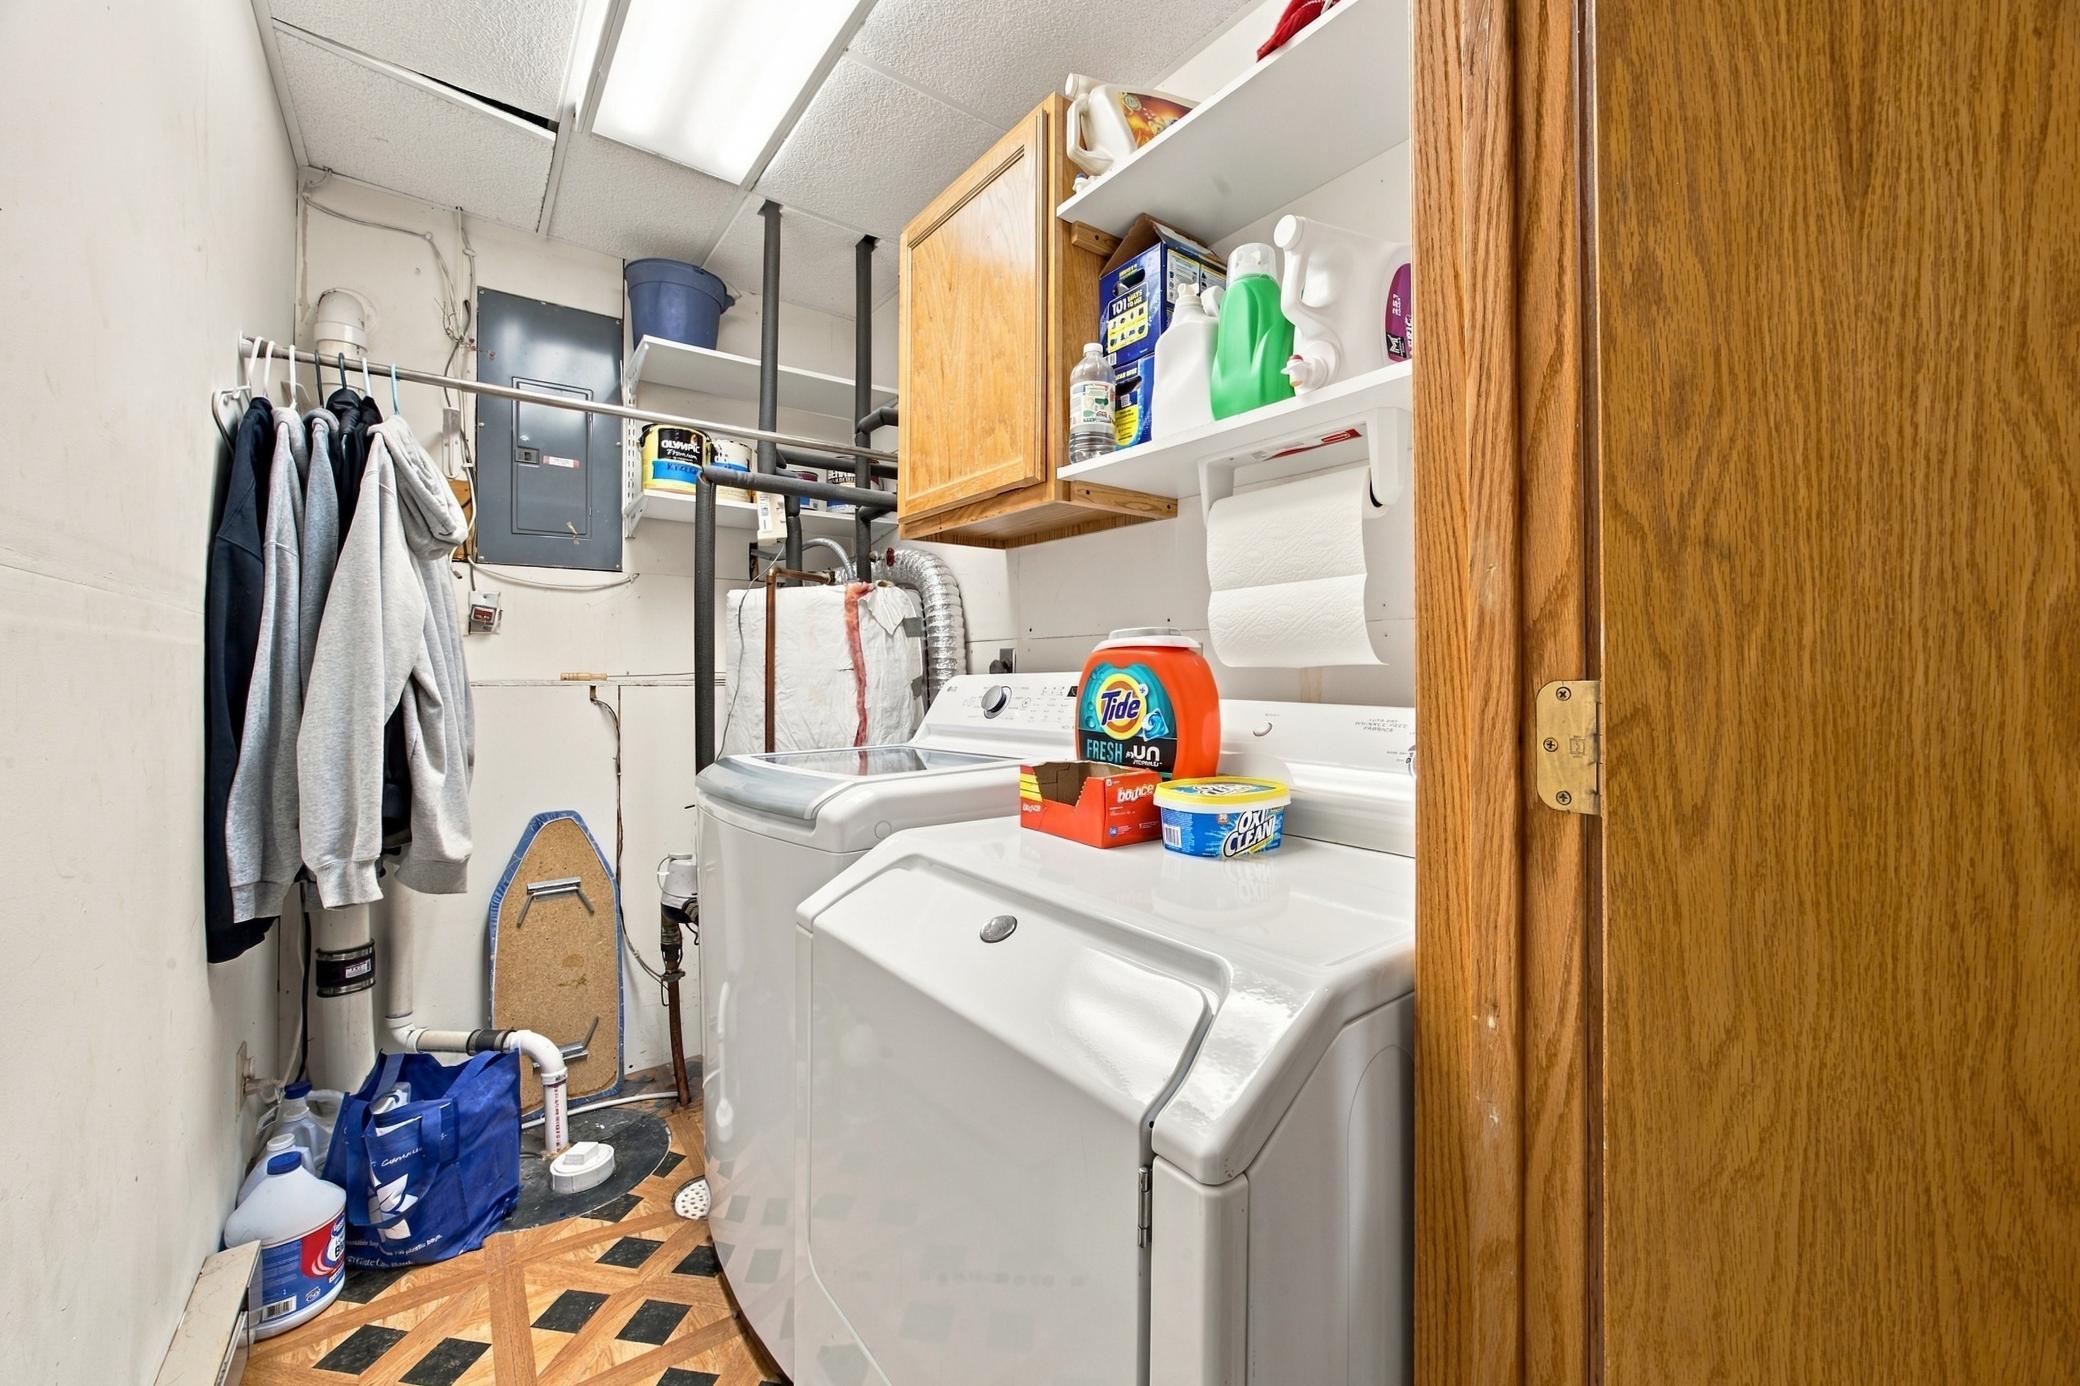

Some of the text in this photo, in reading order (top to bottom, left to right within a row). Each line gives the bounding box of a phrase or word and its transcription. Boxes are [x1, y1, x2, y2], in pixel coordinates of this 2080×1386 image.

[1112, 298, 1127, 316] 101
[661, 439, 700, 454] OLYMPIC
[1101, 689, 1141, 726] Tide
[1086, 739, 1123, 763] FRESH
[1117, 783, 1154, 803] bounce
[1238, 809, 1268, 833] OXI
[1223, 816, 1276, 857] CLEAN
